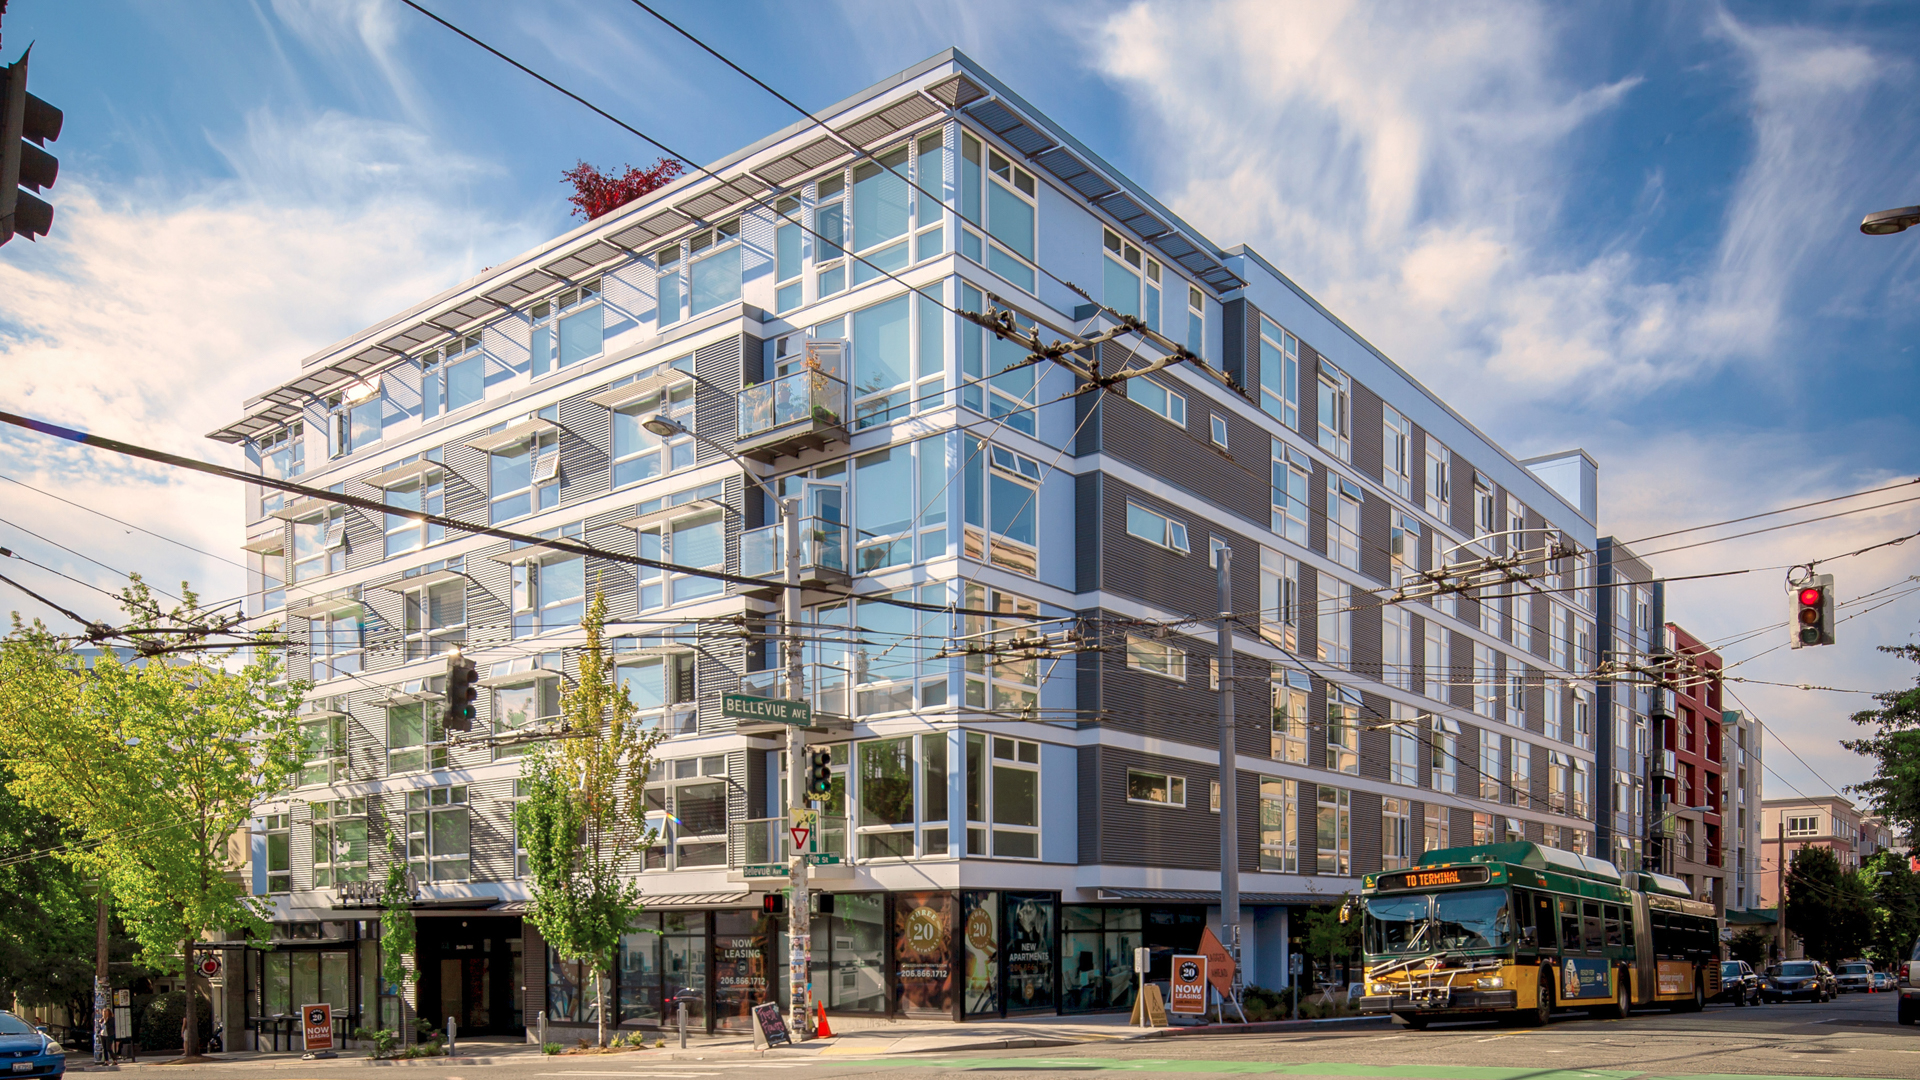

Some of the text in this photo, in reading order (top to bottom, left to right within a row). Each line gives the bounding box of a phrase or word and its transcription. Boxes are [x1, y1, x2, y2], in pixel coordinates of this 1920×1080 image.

[726, 698, 807, 719] BELLEVUE AVE
[744, 866, 771, 876] Bellevue
[772, 866, 782, 875] Ave
[1405, 871, 1461, 887] TO TERMINAL
[334, 881, 390, 899] THRE
[910, 909, 937, 921] THREE
[971, 911, 988, 920] THREE
[913, 923, 934, 940] 20
[973, 922, 987, 937] 20
[731, 939, 753, 948] NOW
[908, 938, 939, 953] APARTMENTS
[1021, 943, 1037, 951] NEW
[724, 949, 760, 958] LEASING
[1009, 952, 1049, 961] APARTMENTS
[901, 970, 947, 978] 206.866.1712
[1183, 968, 1195, 977] 20
[720, 977, 766, 985] 206.866.1712
[1175, 984, 1202, 993] NOW
[312, 1014, 322, 1022] 20
[307, 1026, 329, 1035] NOW
